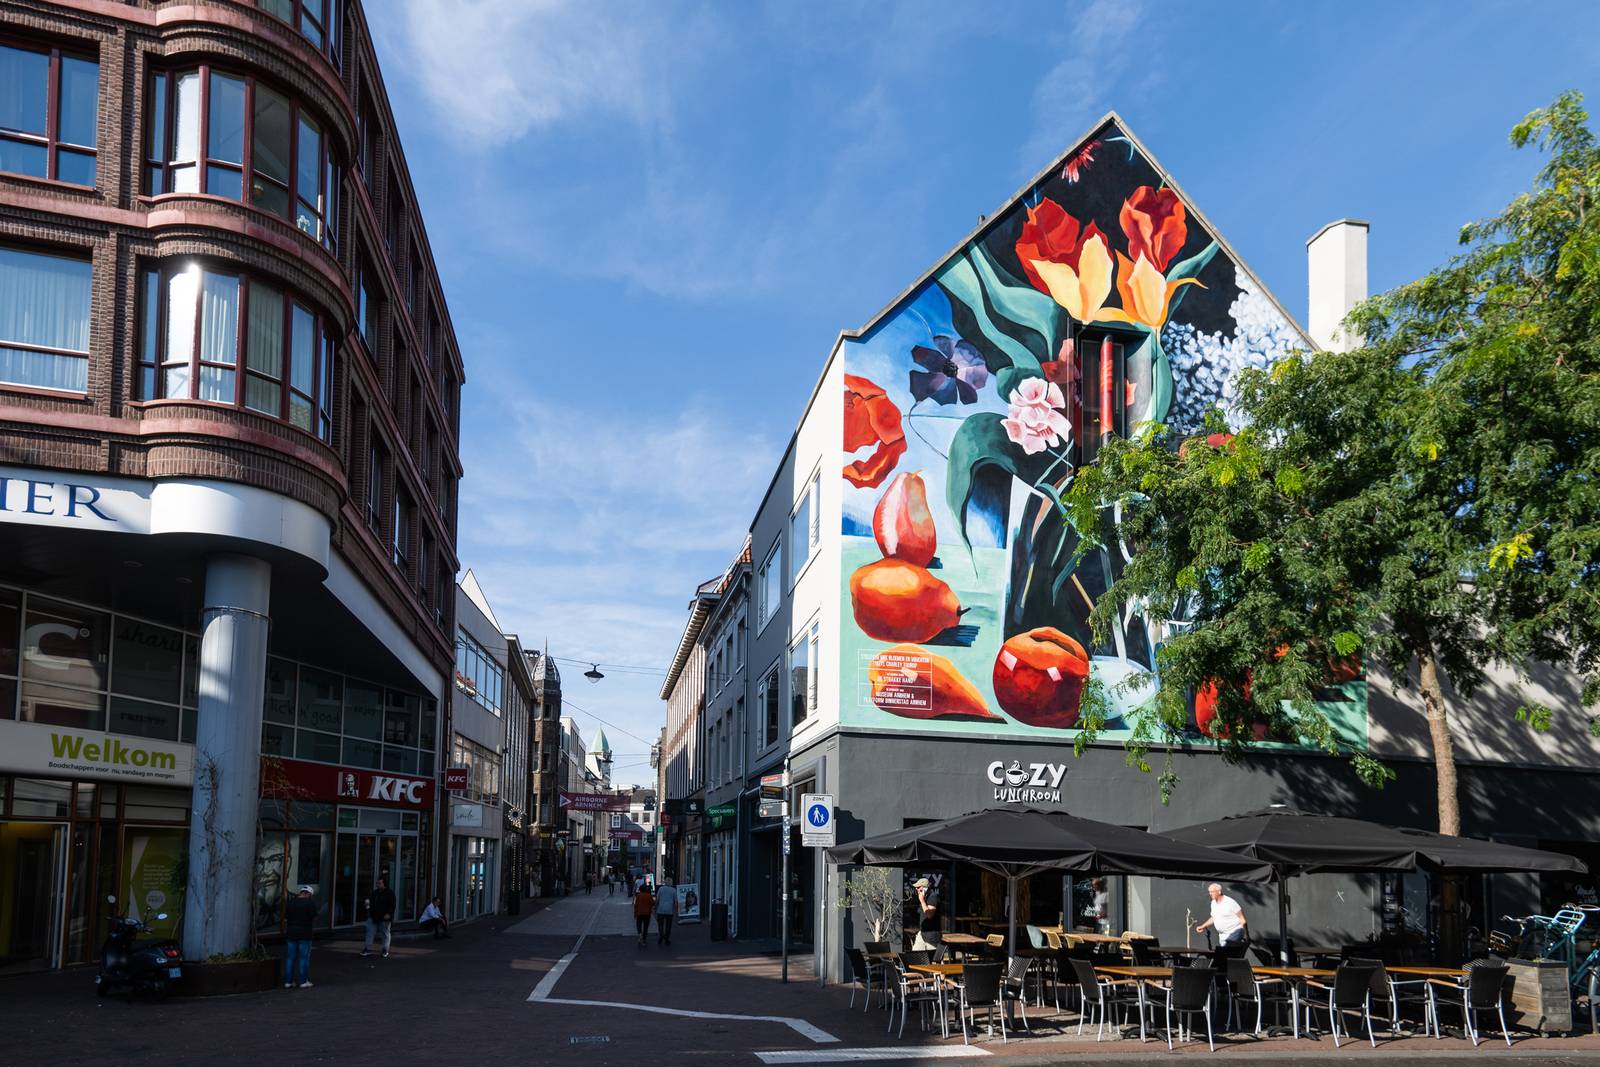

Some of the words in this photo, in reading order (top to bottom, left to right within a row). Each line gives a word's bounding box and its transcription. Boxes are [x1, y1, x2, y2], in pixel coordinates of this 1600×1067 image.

[50, 733, 176, 769] Welkom
[48, 761, 95, 772] Boodschappen
[122, 769, 146, 777] vandaag
[369, 775, 427, 804] KFC
[994, 787, 1061, 803] LUNCHROOM
[575, 796, 608, 804] AIRBORNE
